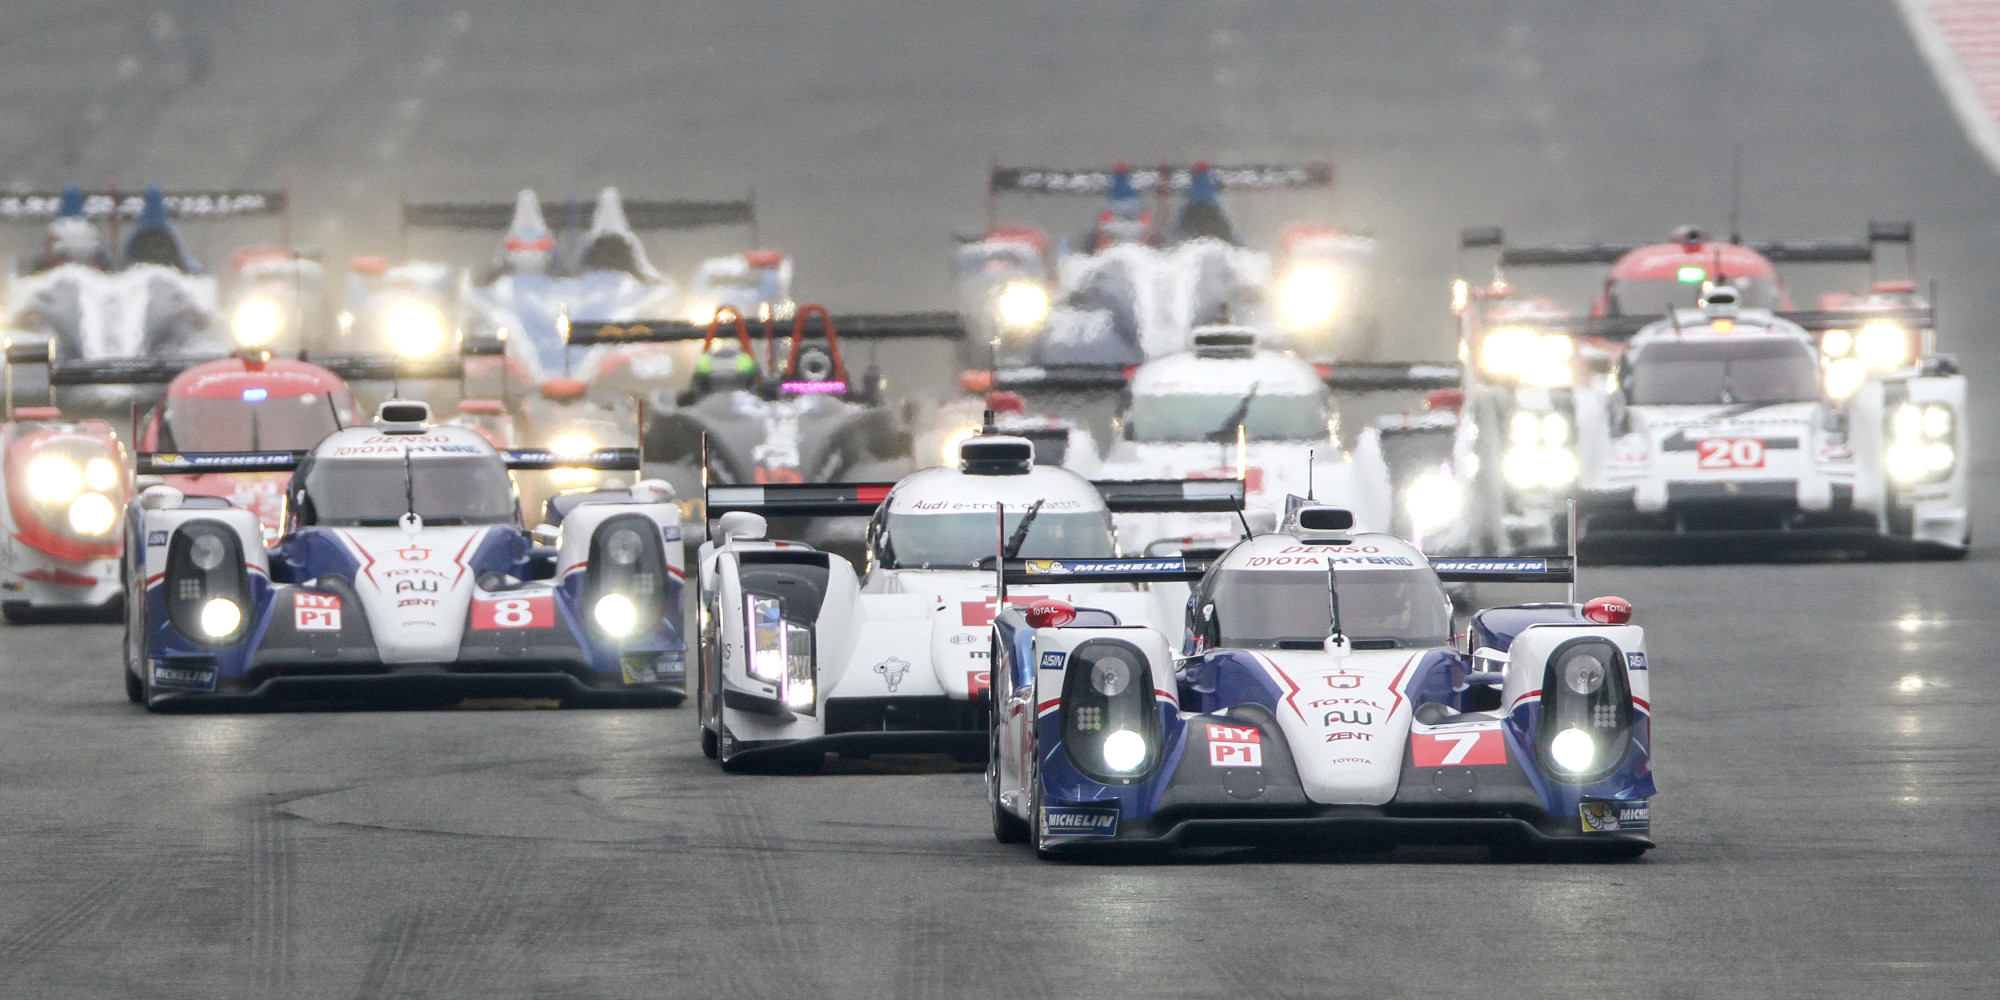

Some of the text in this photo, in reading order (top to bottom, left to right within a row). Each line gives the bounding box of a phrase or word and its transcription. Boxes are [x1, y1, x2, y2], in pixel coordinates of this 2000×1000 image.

[363, 435, 450, 444] DENSO
[334, 445, 401, 456] TOYOTA
[1700, 439, 1764, 468] 20
[194, 455, 289, 465] MICHELIN
[911, 500, 948, 510] Audi
[1280, 545, 1380, 554] DENSO
[1073, 562, 1182, 572] MICHELIN
[1244, 556, 1415, 568] TOYOTA HYBRID
[1435, 562, 1545, 571] MICHELIN
[381, 568, 450, 579] TOTAL
[295, 594, 336, 608] HY
[494, 599, 534, 627] 8
[1033, 606, 1059, 616] TOTAL
[1602, 602, 1628, 614] TOTAL
[301, 611, 332, 626] P1
[1041, 654, 1064, 667] AISIN
[1307, 697, 1385, 710] TOTAL
[1209, 726, 1256, 740] HY
[1325, 731, 1374, 742] ZENT
[1215, 745, 1252, 763] P1
[1434, 732, 1480, 765] 7
[1332, 757, 1372, 765] TOYOTA
[1048, 813, 1115, 828] MICHELIN
